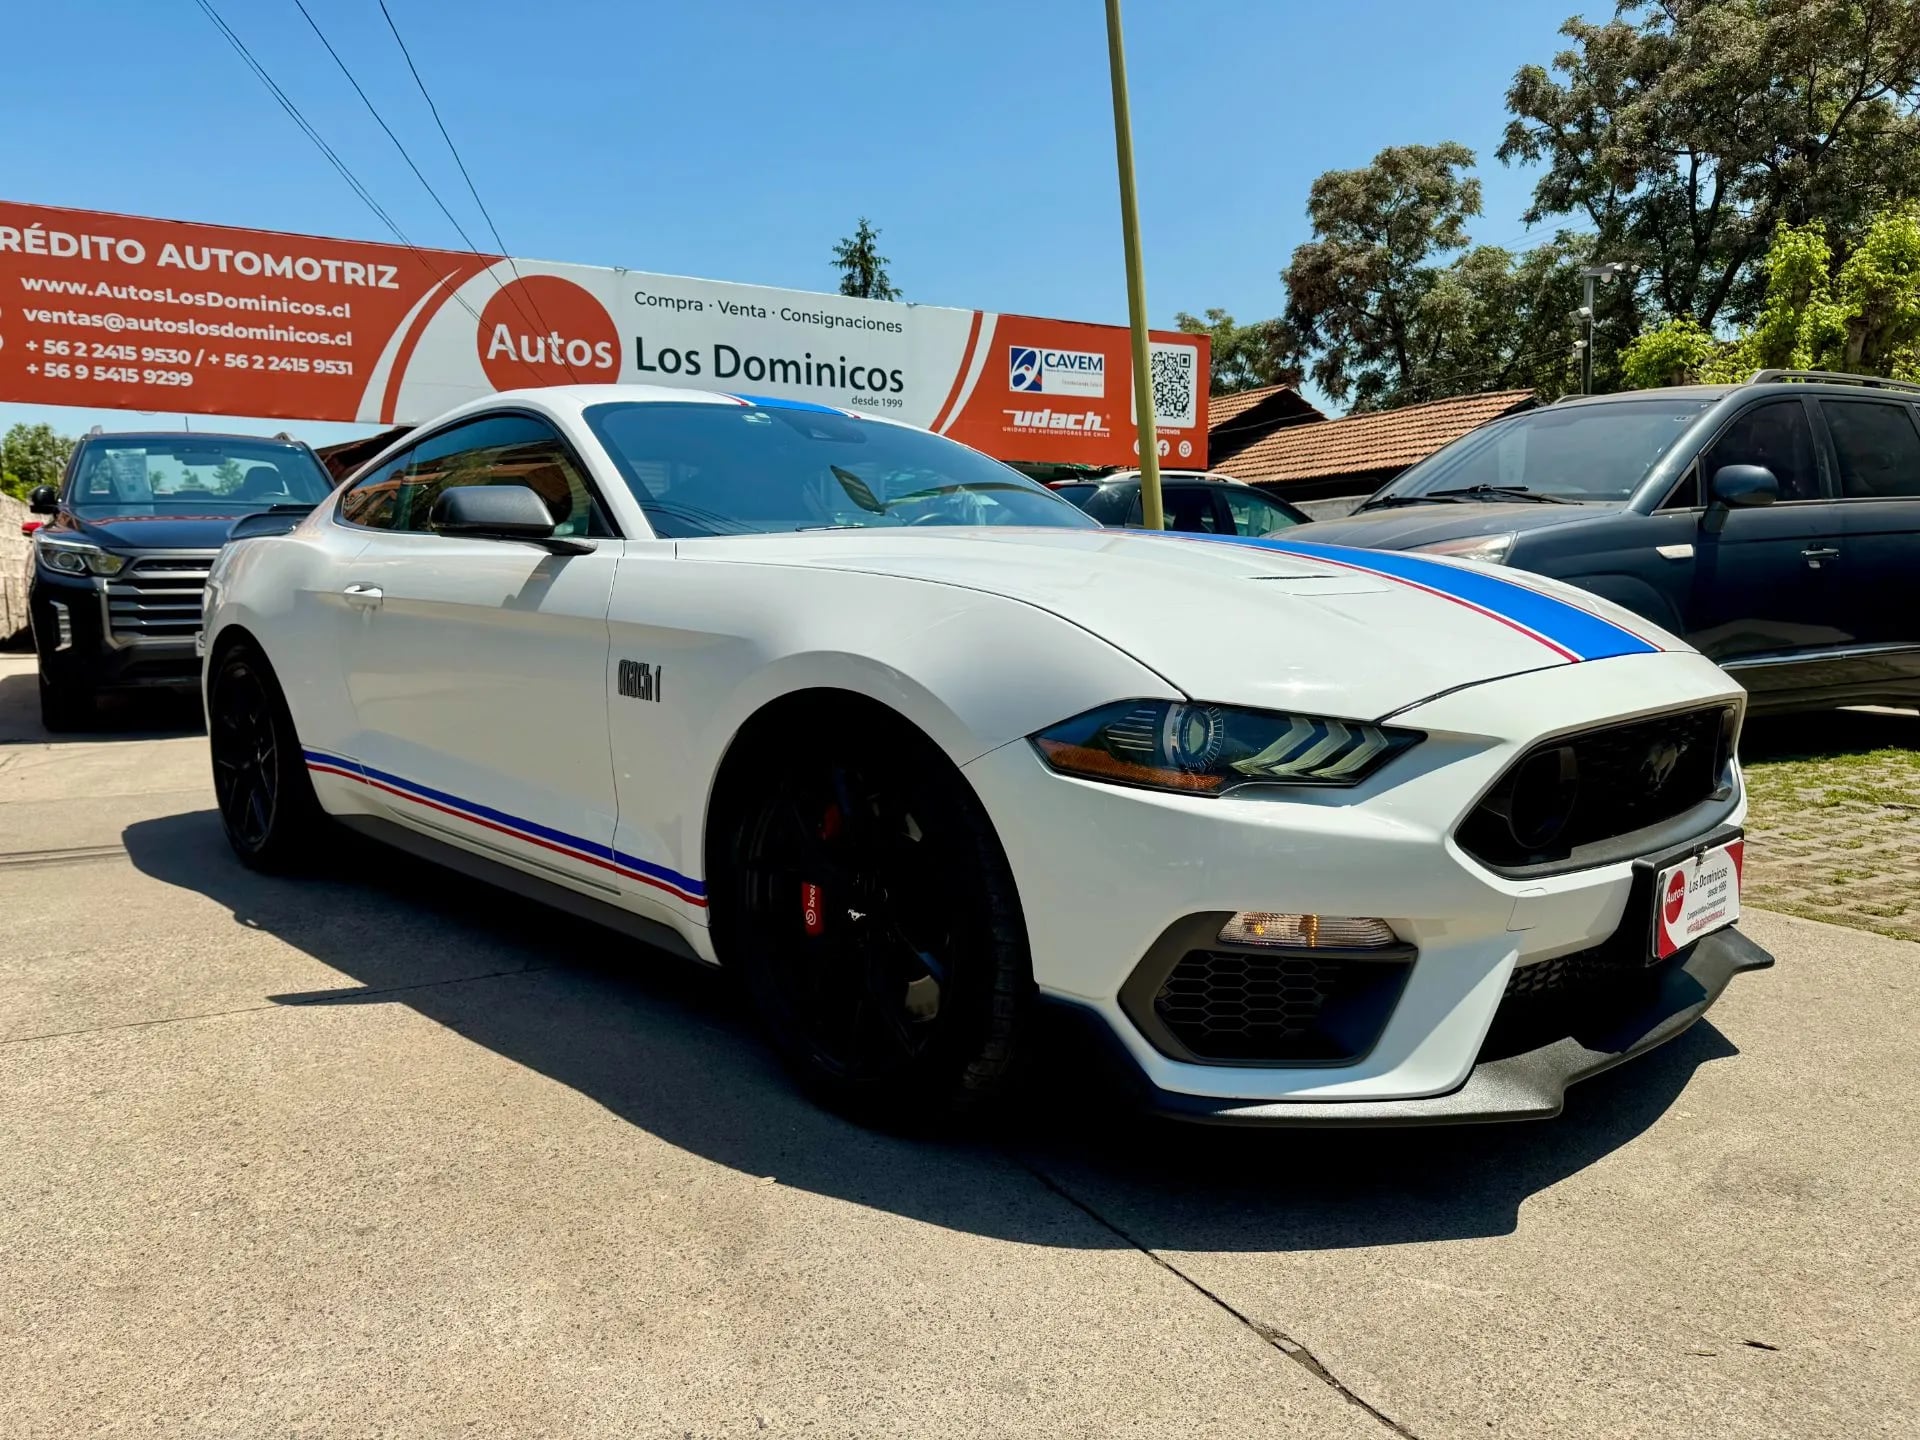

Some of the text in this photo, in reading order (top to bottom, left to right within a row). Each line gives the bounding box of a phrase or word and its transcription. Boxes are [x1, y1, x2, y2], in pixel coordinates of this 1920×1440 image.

[157, 243, 399, 290] AUTOMOTRIZ
[20, 277, 351, 318] www.AutosLosDominicos.cl
[634, 291, 903, 333] Compra Venta Consignaciones
[23, 307, 352, 346] ventas@autoslosdominicos.cl
[44, 339, 70, 356] 56
[74, 342, 88, 357] 2
[91, 343, 138, 361] 2415
[141, 347, 191, 365] 9530
[224, 352, 249, 369] 56
[252, 355, 265, 370] 2
[268, 356, 310, 373] 2415
[313, 359, 353, 375] 9531
[486, 323, 613, 369] Autos
[1044, 352, 1103, 372] CAVEM
[44, 362, 71, 378] 56
[75, 364, 89, 379] 9
[93, 366, 139, 383] 5415
[143, 369, 193, 387] 9299
[636, 336, 904, 393] Los Dominicos
[851, 395, 903, 408] desde 1999
[1002, 408, 1111, 432] udach
[1665, 886, 1684, 906] Autos
[1689, 880, 1699, 893] Los
